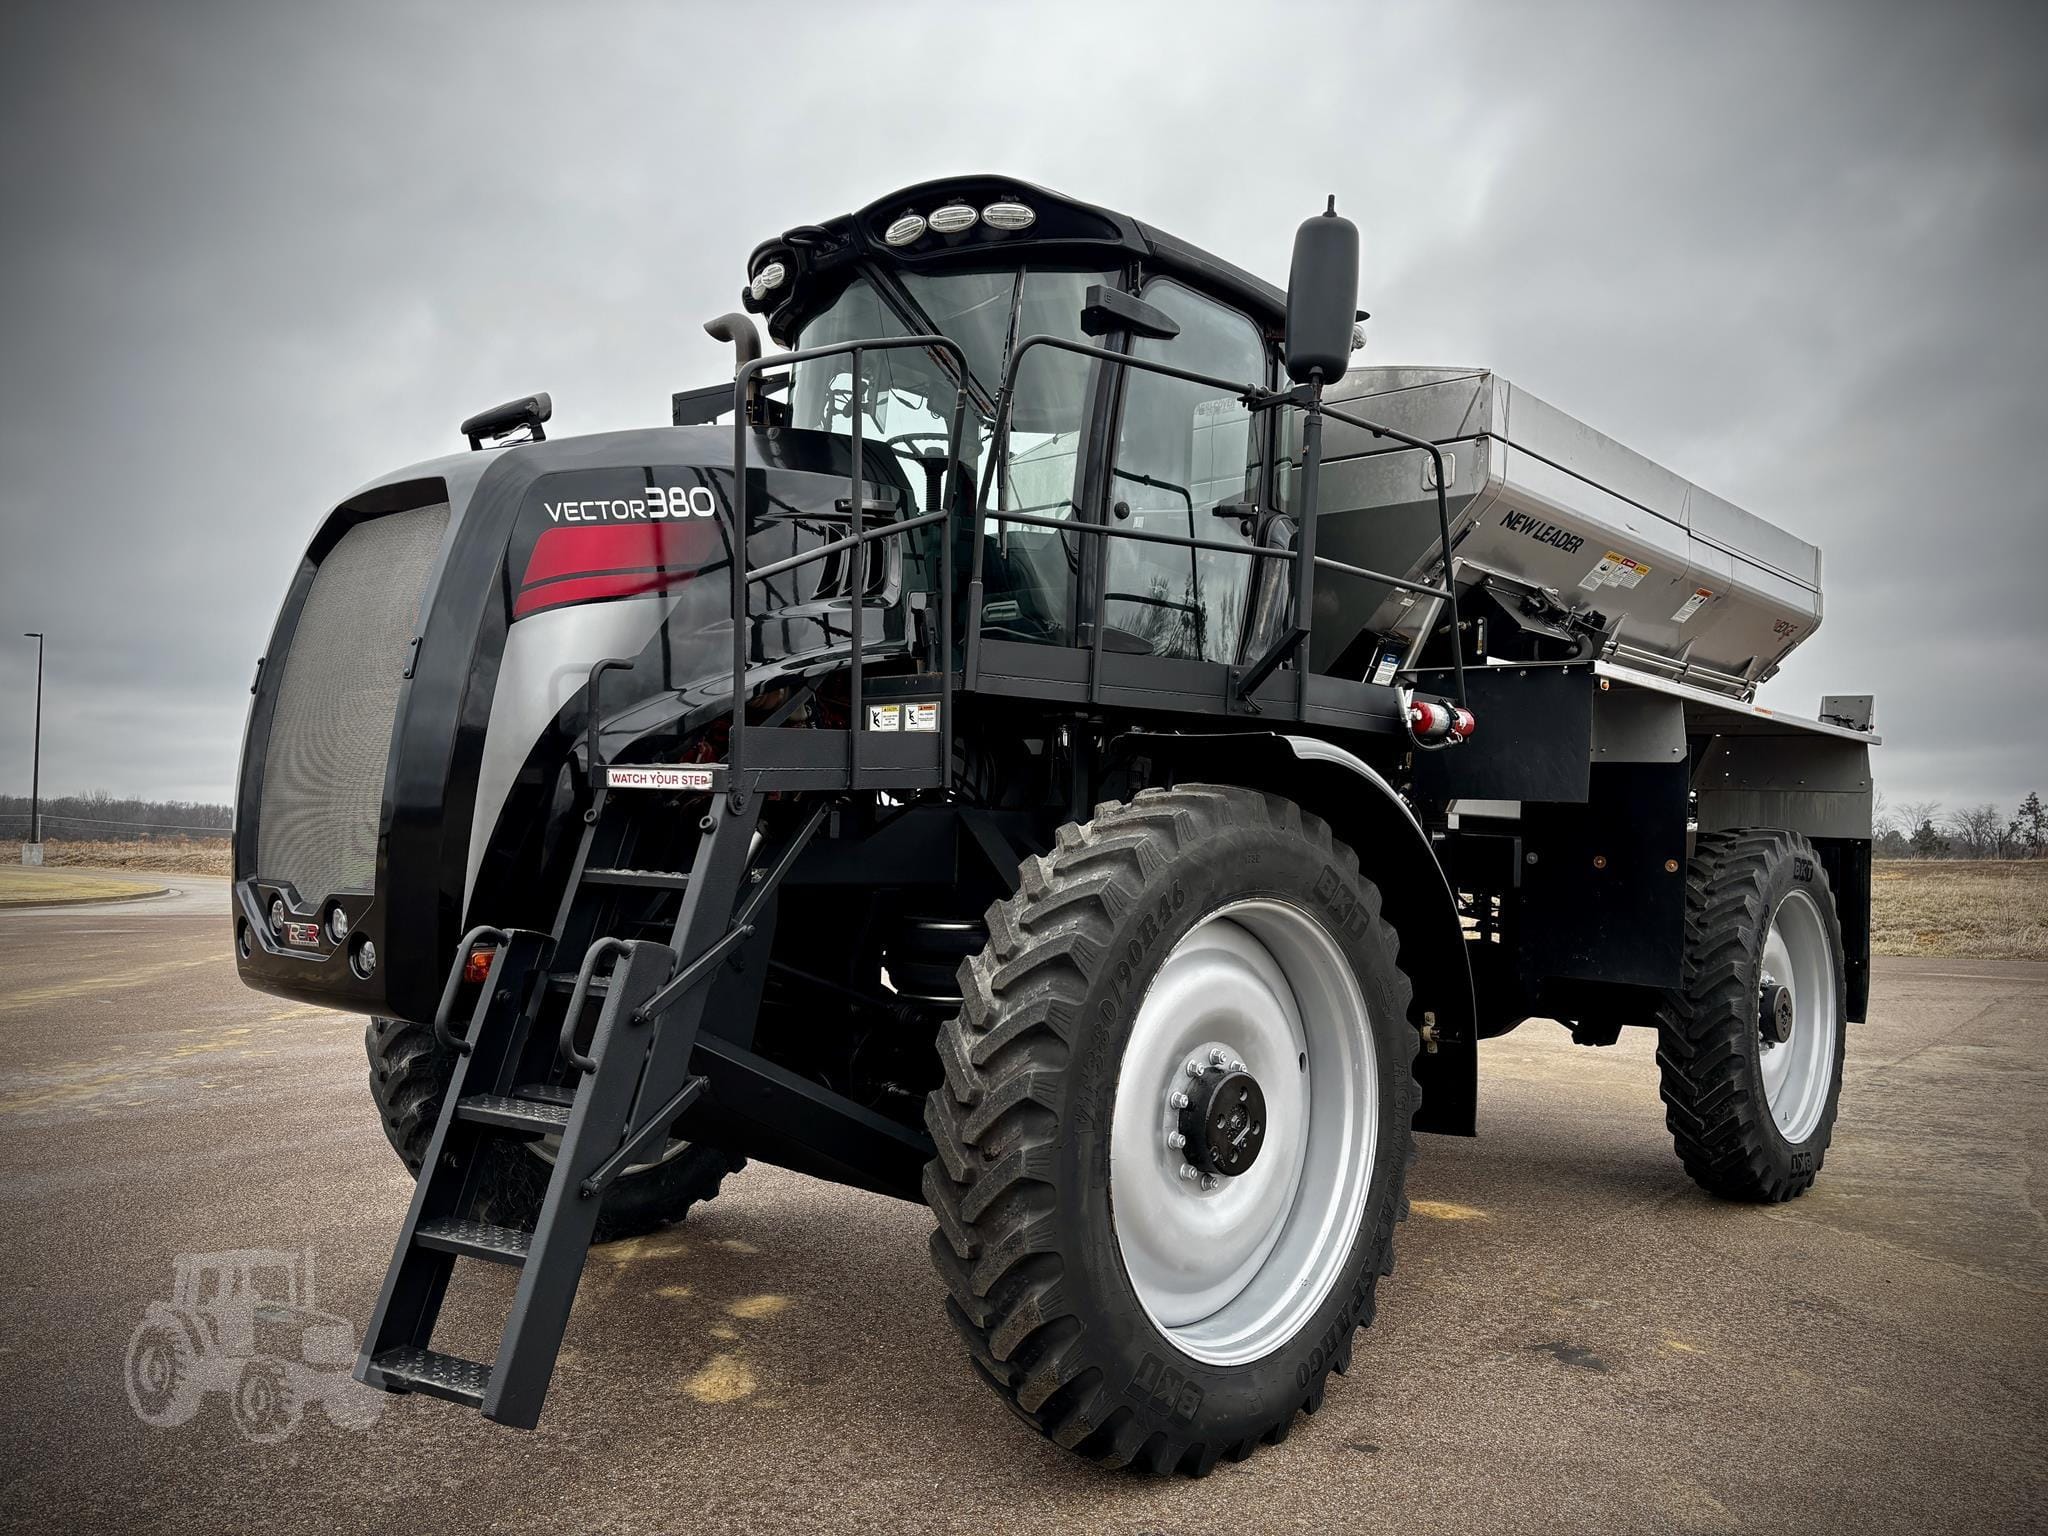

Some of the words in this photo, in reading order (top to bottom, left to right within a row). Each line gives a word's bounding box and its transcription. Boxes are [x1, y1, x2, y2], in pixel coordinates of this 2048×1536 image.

[1500, 510, 1541, 535] NEW
[1532, 522, 1585, 554] LEADER
[611, 773, 647, 784] WATCH
[649, 774, 679, 785] YOUR
[681, 775, 708, 786] STEP
[1793, 857, 1813, 882] BKT
[1314, 865, 1370, 940] BKT
[1124, 1352, 1204, 1424] BKT
